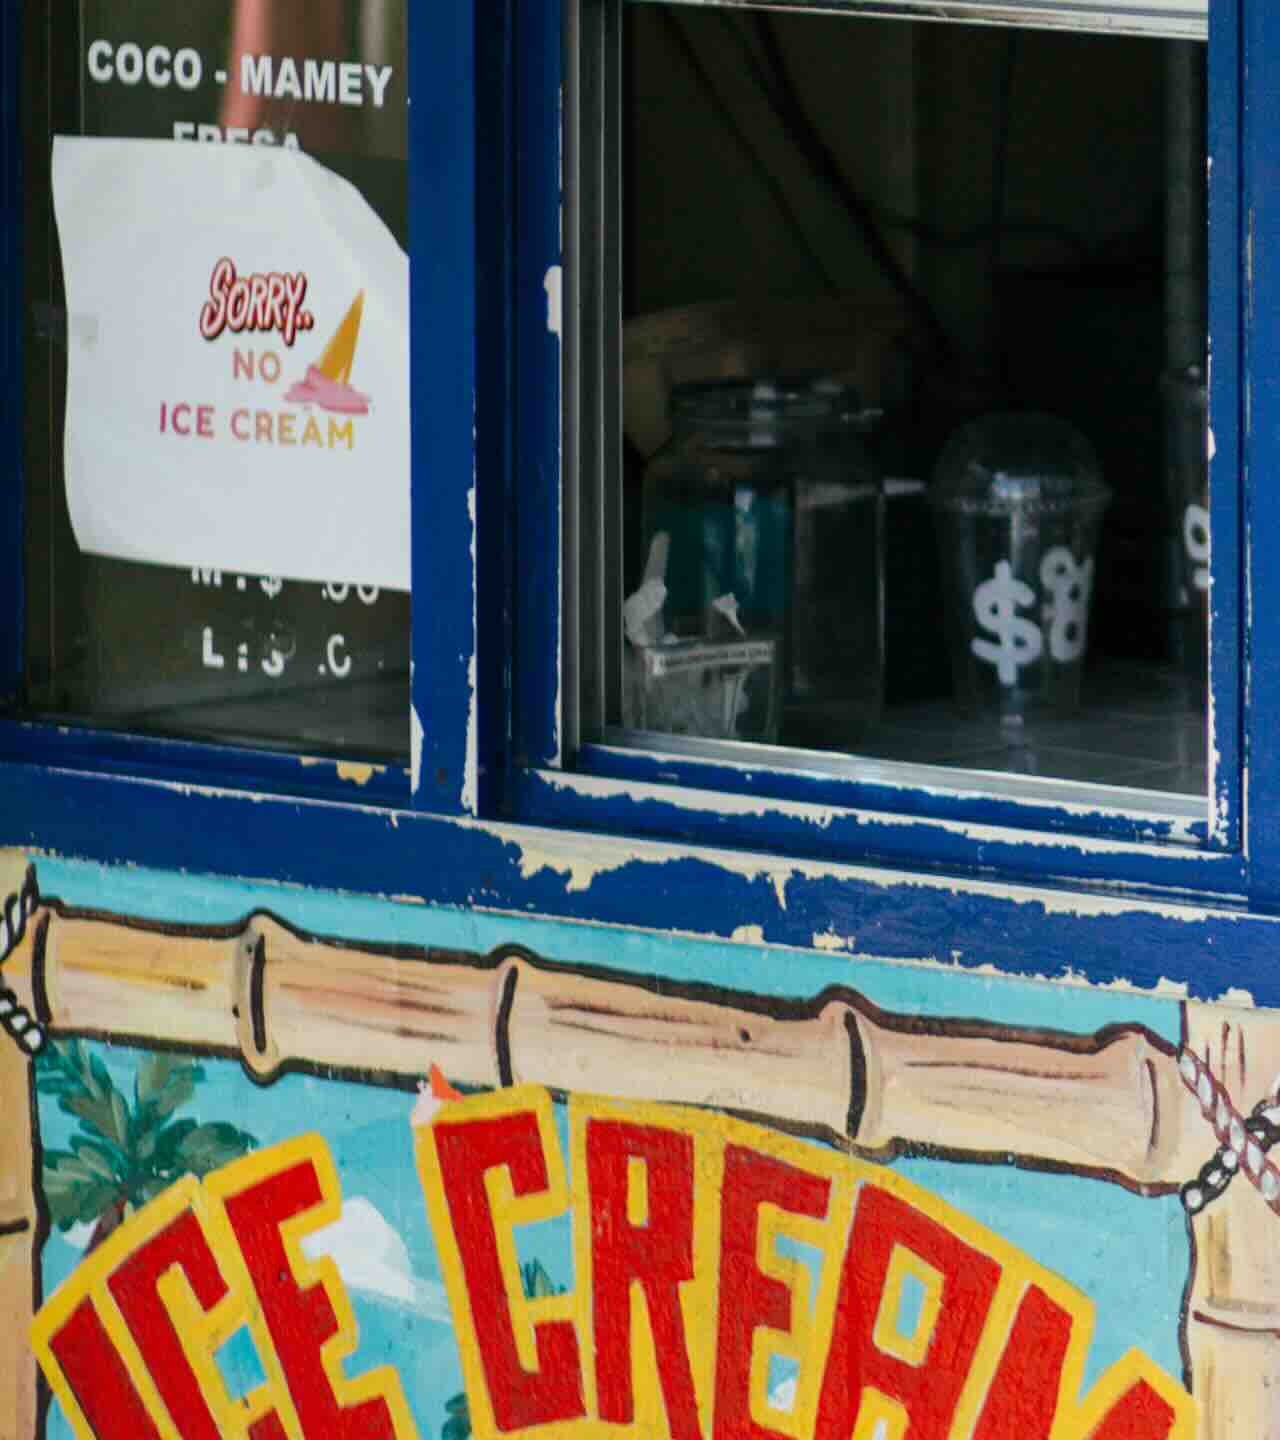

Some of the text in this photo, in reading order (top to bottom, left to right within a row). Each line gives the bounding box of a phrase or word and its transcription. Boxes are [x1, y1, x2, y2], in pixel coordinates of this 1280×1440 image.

[87, 40, 202, 90] COCO
[240, 54, 393, 108] MAMEY
[232, 348, 282, 384] NO
[159, 402, 355, 451] ICE CREAM
